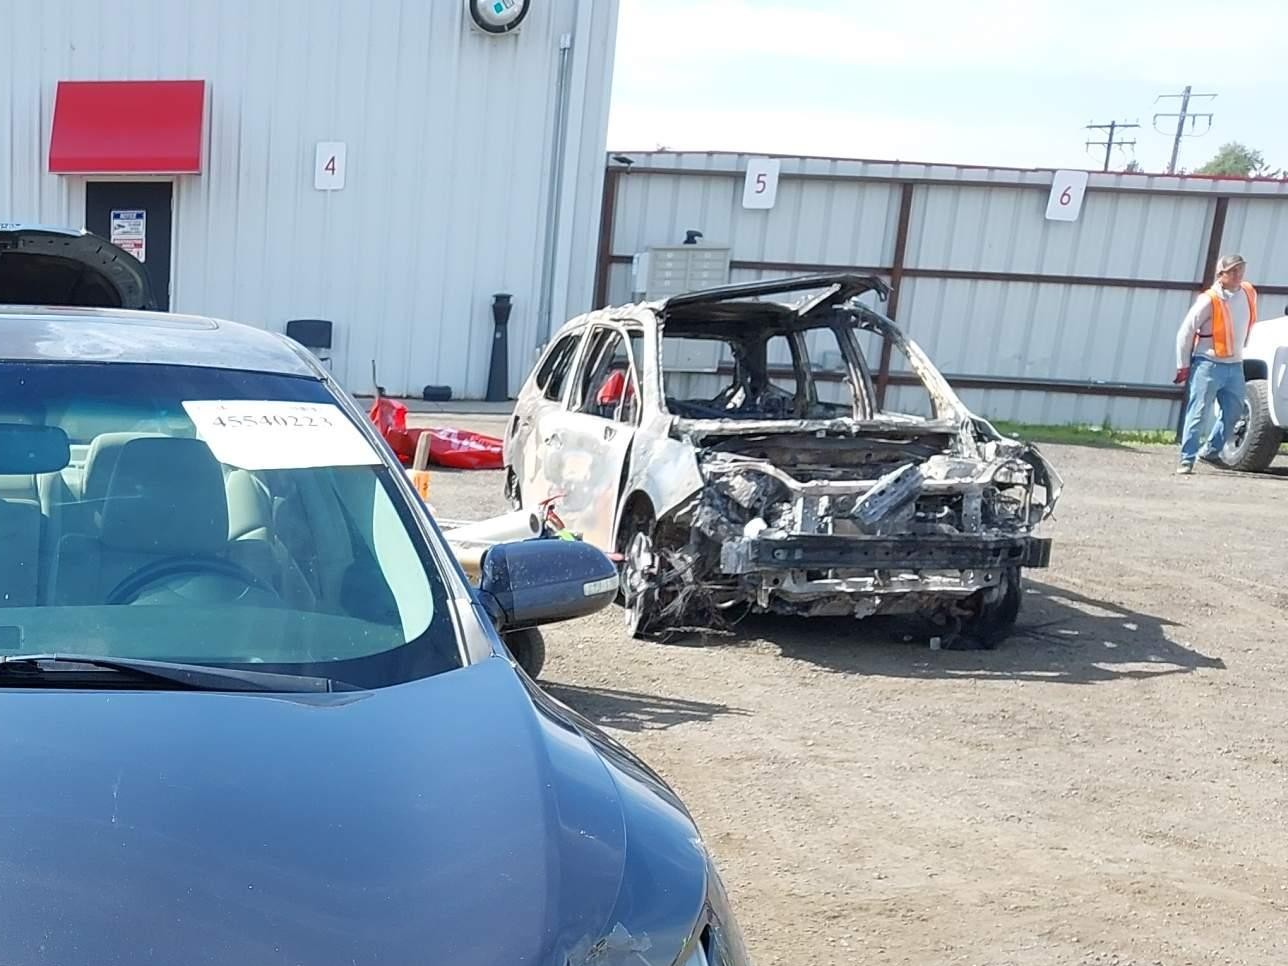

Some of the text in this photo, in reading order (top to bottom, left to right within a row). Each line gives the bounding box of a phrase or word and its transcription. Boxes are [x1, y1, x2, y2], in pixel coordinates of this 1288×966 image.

[324, 155, 336, 176] 4
[754, 173, 767, 194] 5
[1059, 185, 1072, 206] 6
